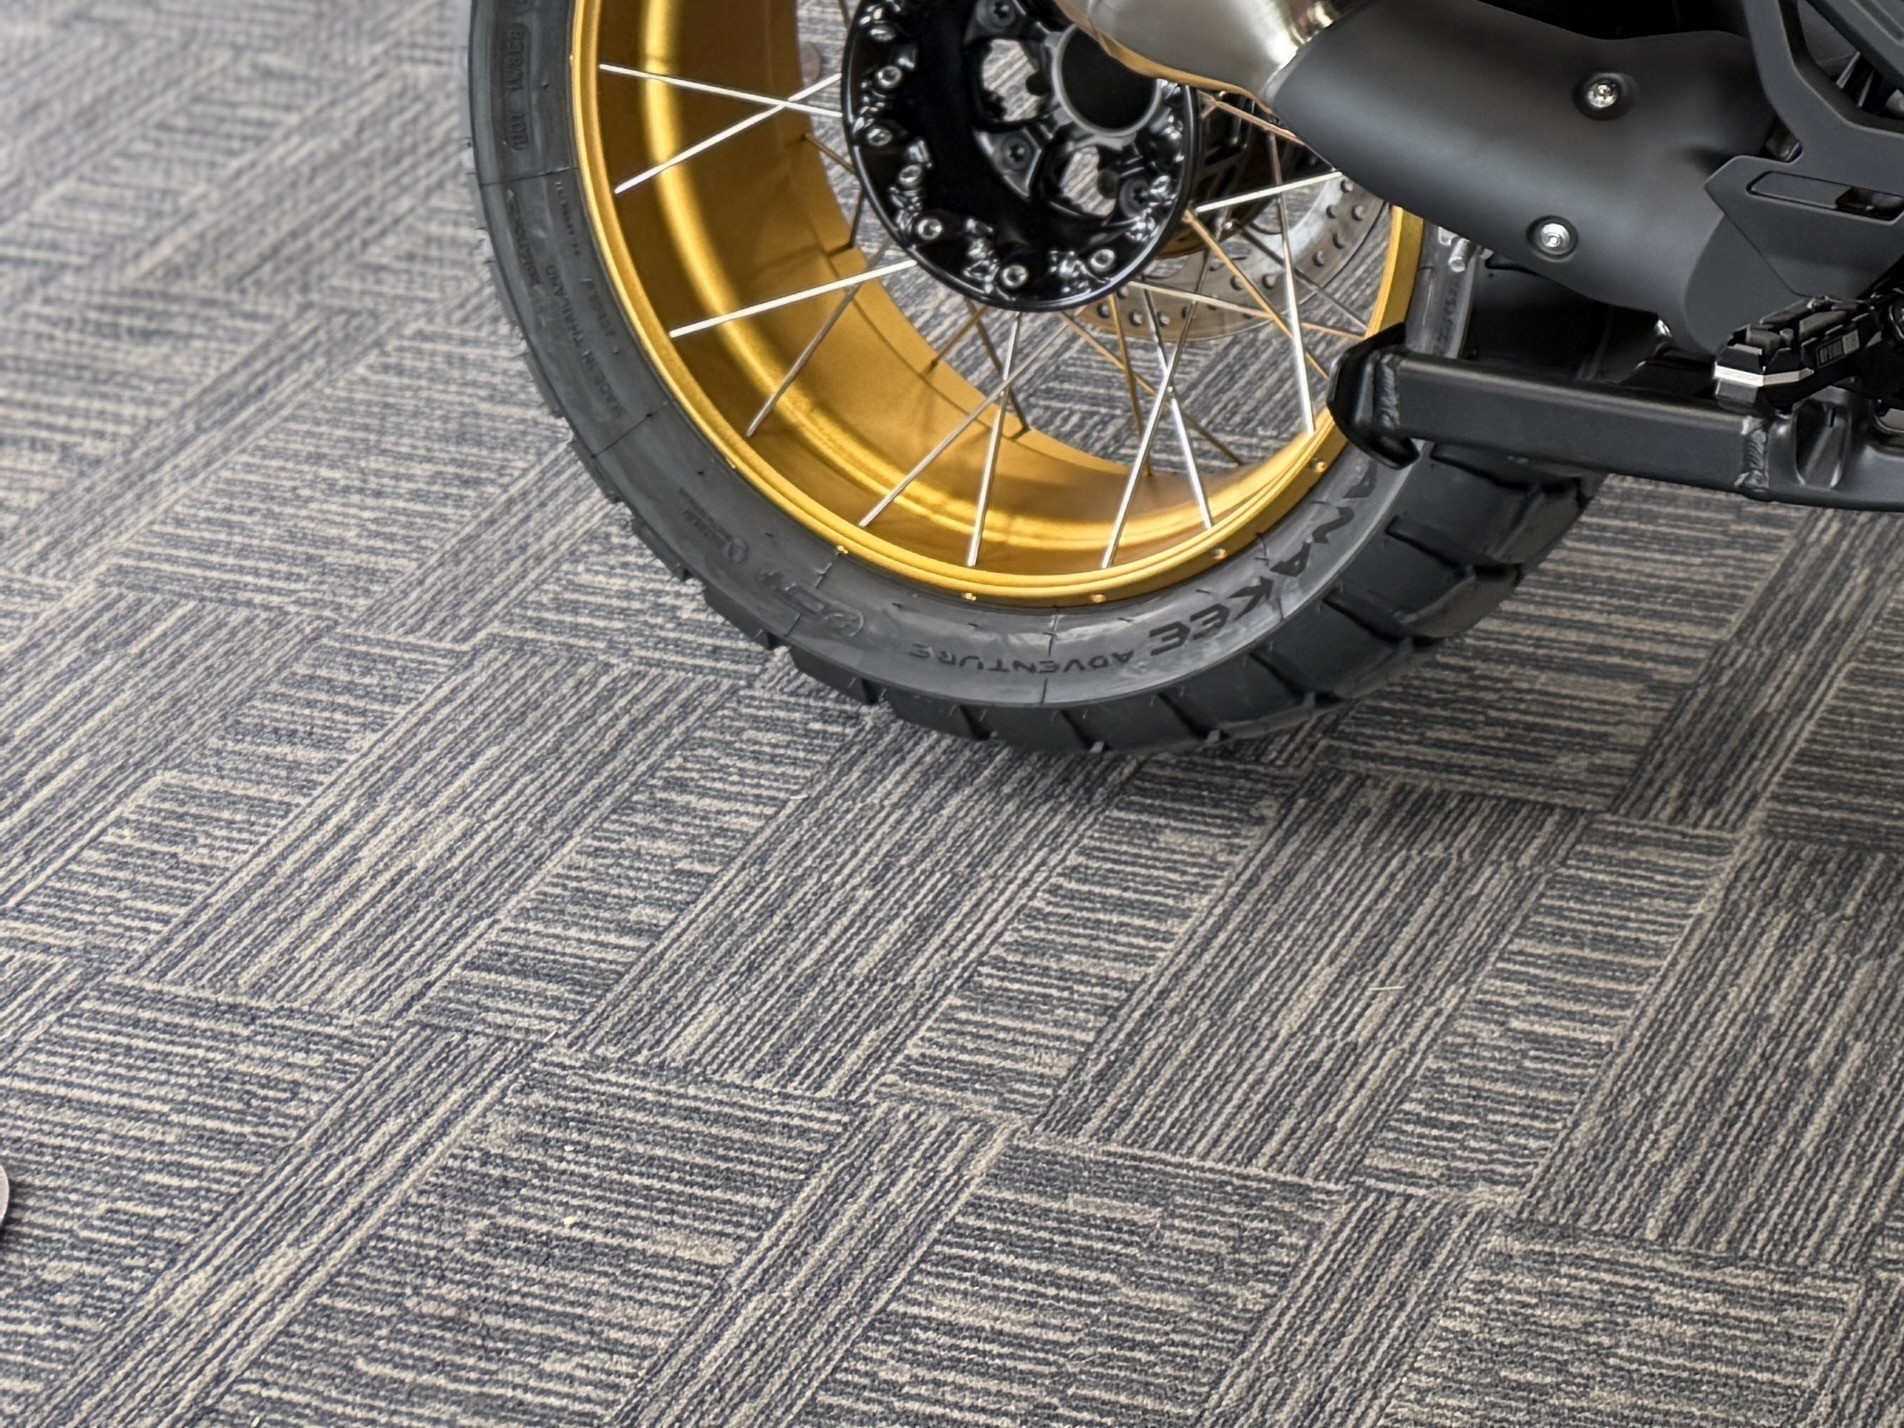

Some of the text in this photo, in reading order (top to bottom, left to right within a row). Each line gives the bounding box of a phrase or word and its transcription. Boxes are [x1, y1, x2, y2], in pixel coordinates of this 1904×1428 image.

[505, 109, 529, 144] DOT
[543, 262, 587, 347] THAILAND
[579, 349, 599, 371] IN
[591, 370, 626, 420] MADE
[1143, 462, 1386, 657] ANAKEE
[905, 641, 1138, 677] ADVENTURE
